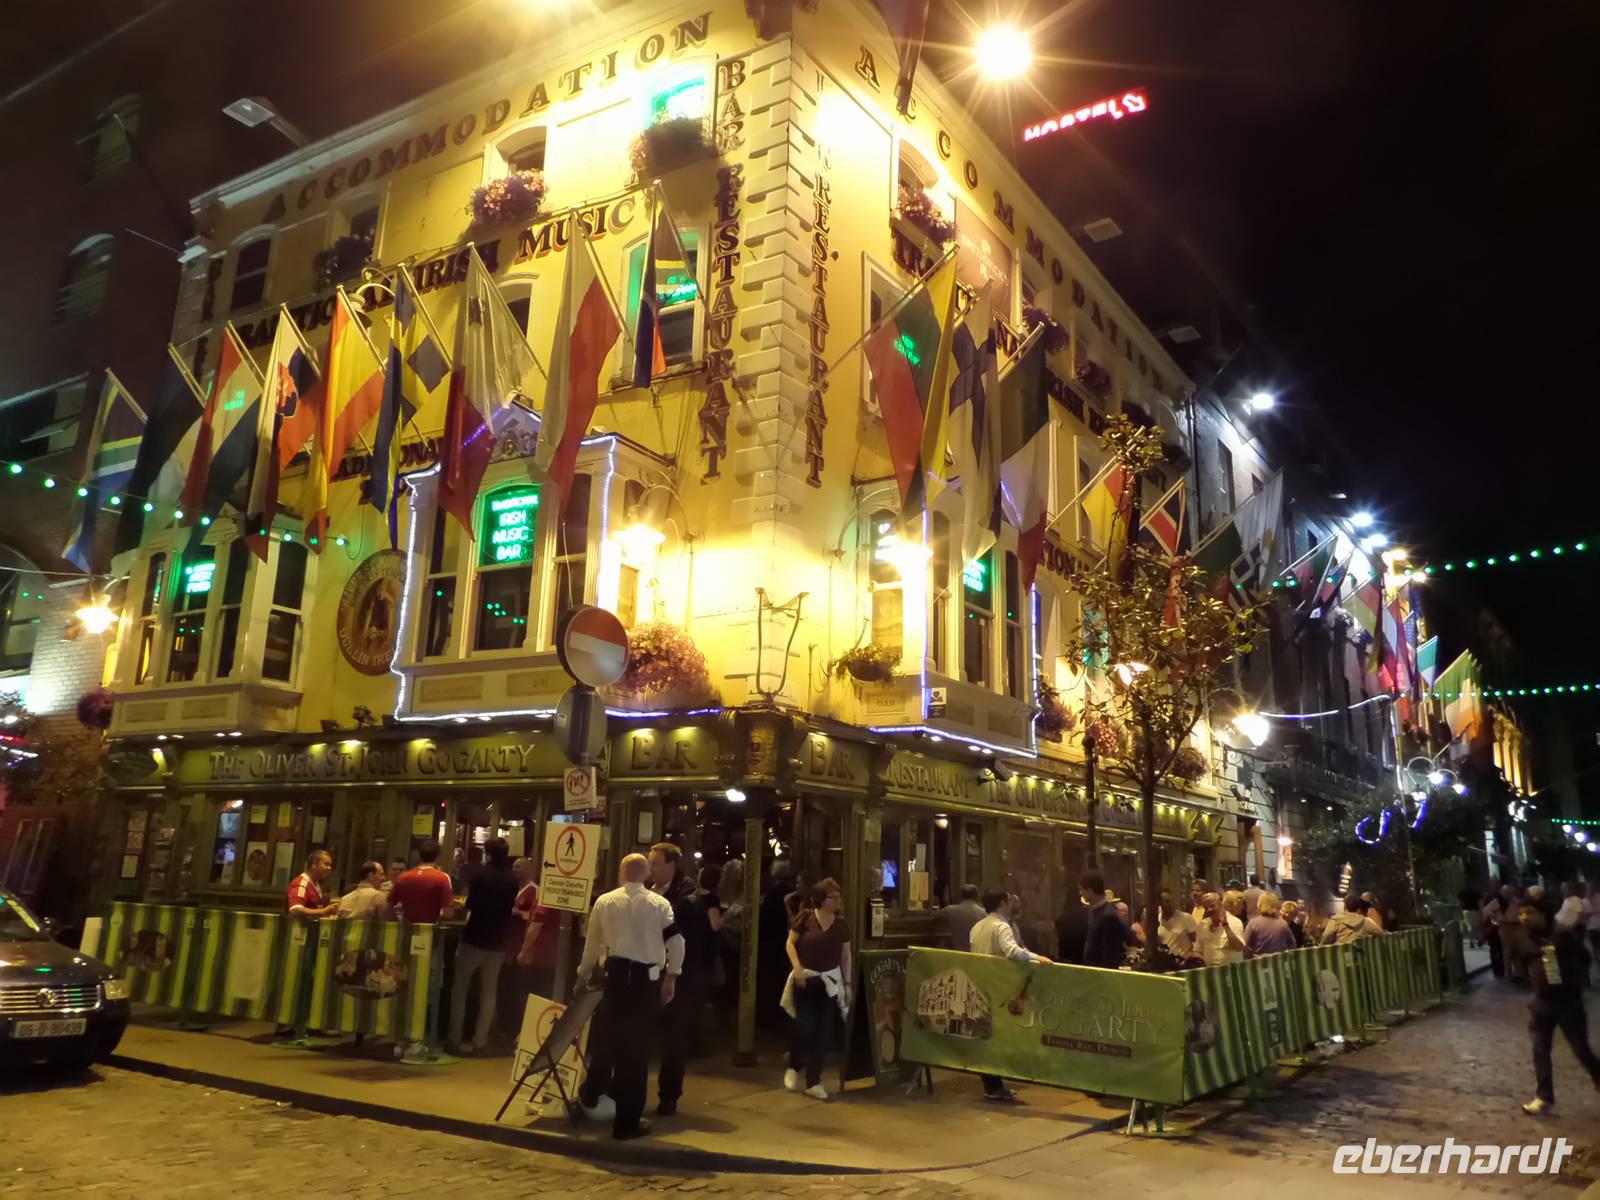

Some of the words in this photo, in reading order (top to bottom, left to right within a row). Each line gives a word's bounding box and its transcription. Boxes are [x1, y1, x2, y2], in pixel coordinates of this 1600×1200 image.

[263, 12, 712, 223] ACCOMMODATION
[715, 57, 746, 150] BAR
[512, 196, 636, 265] MUSIC
[700, 162, 745, 484] RESTAURANT
[805, 171, 832, 488] RESTAURANT
[417, 742, 535, 775] GOGARTY
[631, 734, 697, 770] BAR
[808, 738, 856, 781] BAR
